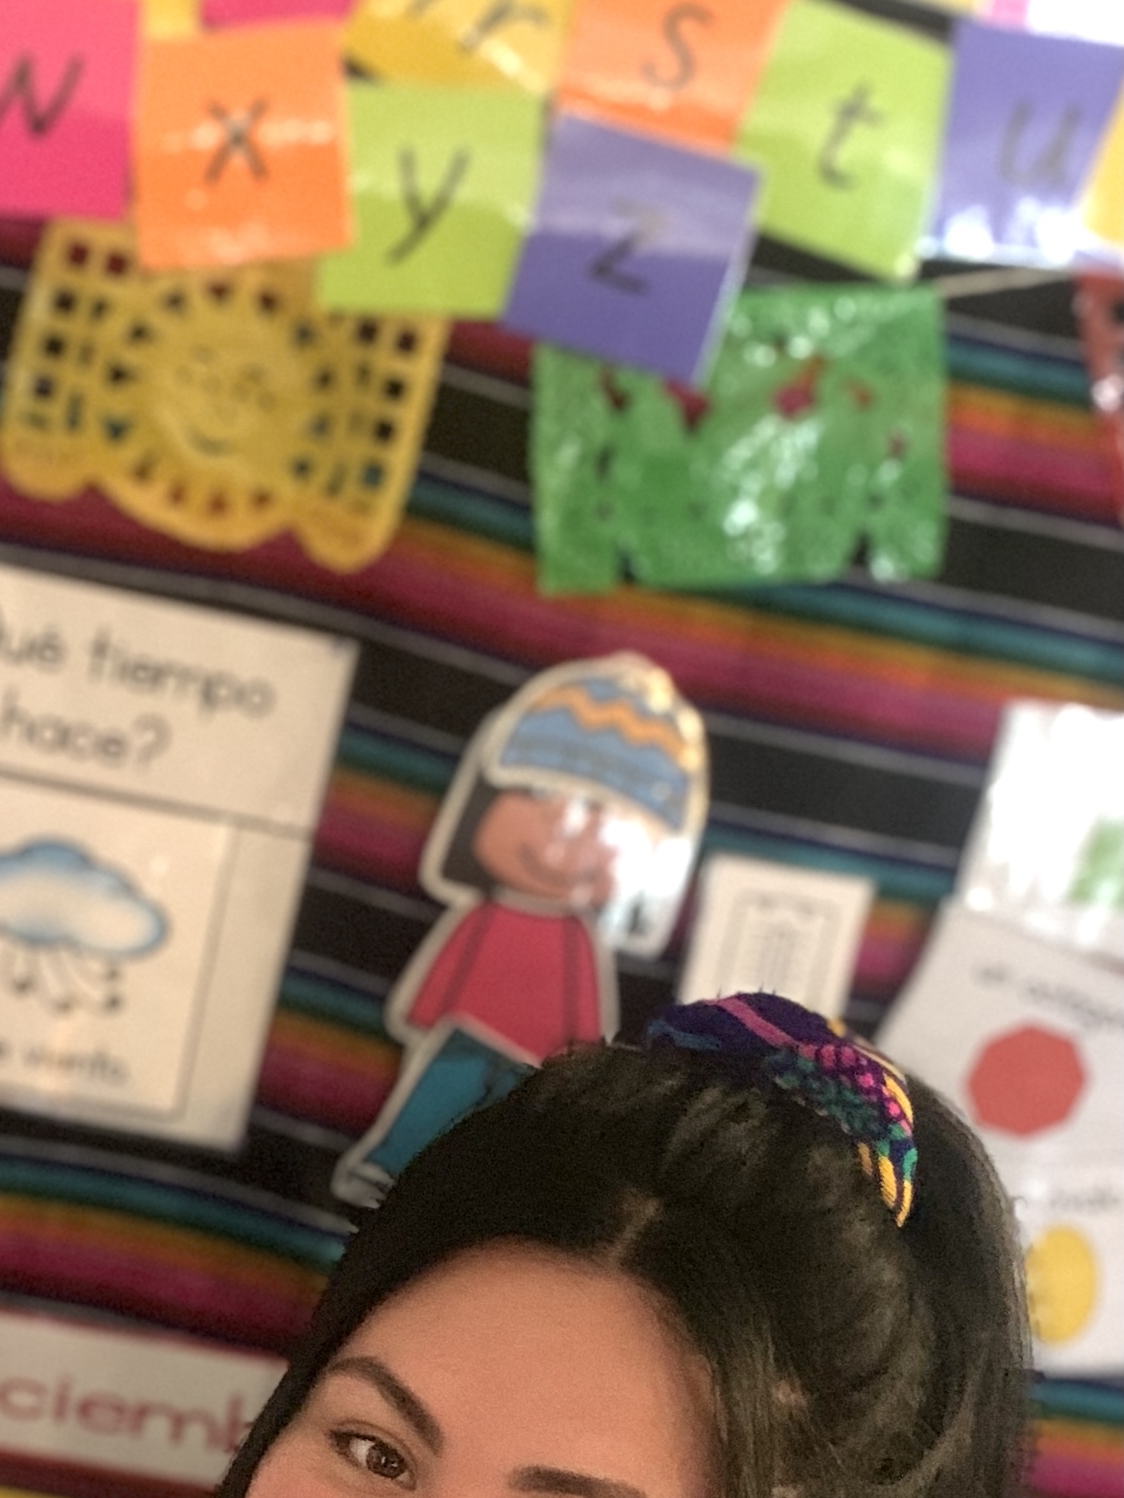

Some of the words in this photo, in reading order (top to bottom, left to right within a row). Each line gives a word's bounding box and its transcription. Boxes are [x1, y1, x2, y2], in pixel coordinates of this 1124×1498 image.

[816, 82, 884, 191] t
[994, 97, 1083, 192] u
[384, 147, 470, 267] y
[88, 622, 278, 726] tiempo
